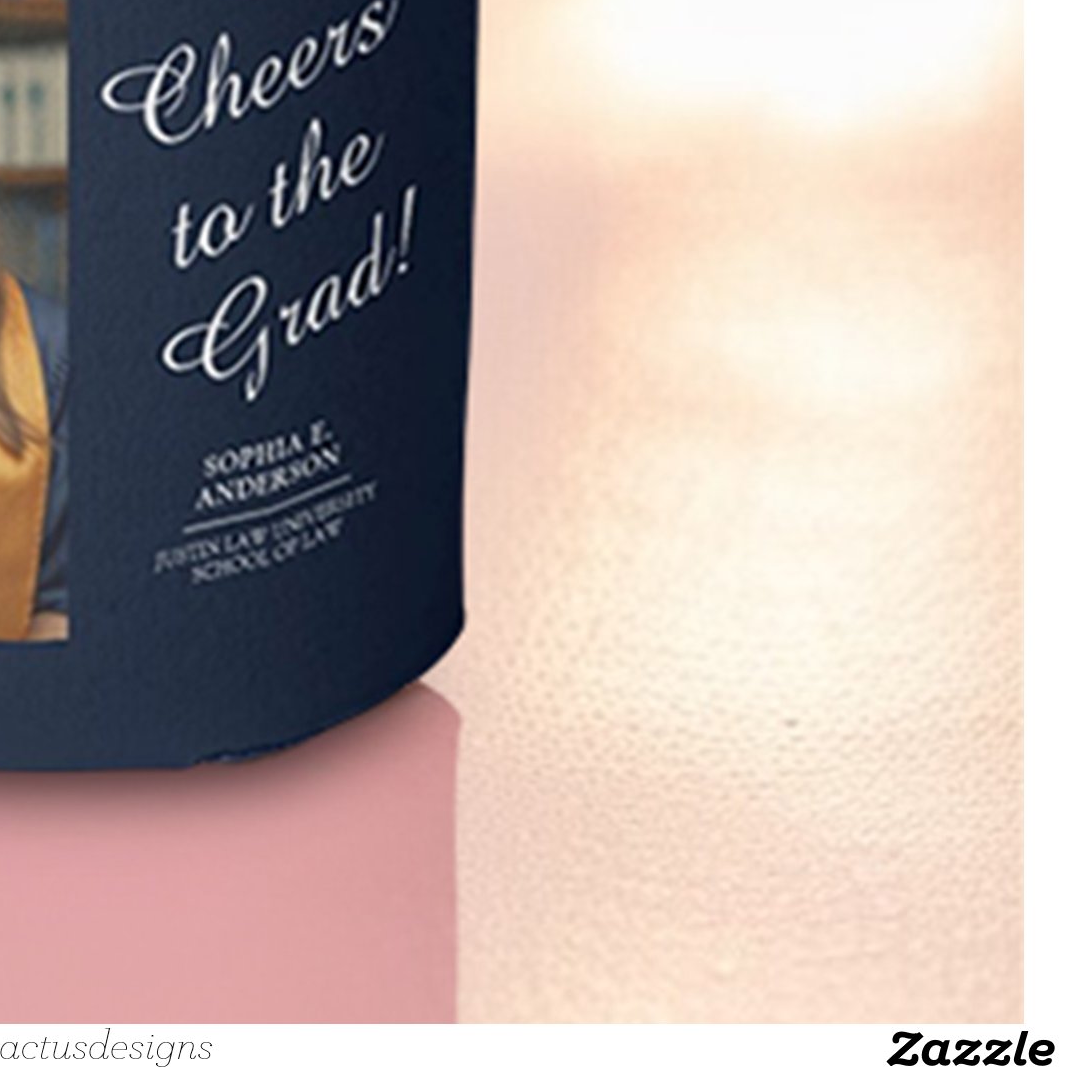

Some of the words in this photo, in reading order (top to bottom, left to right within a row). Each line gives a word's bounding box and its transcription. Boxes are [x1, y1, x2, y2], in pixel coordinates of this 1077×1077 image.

[173, 203, 255, 269] to
[269, 118, 385, 227] the
[162, 185, 416, 401] Grad!
[194, 442, 341, 511] ANDERSON
[202, 432, 304, 479] SOPHIA
[271, 480, 379, 541] UNIVERSITY
[191, 549, 270, 585] SCHOOL
[272, 535, 300, 562] OF
[302, 516, 345, 552] LAW
